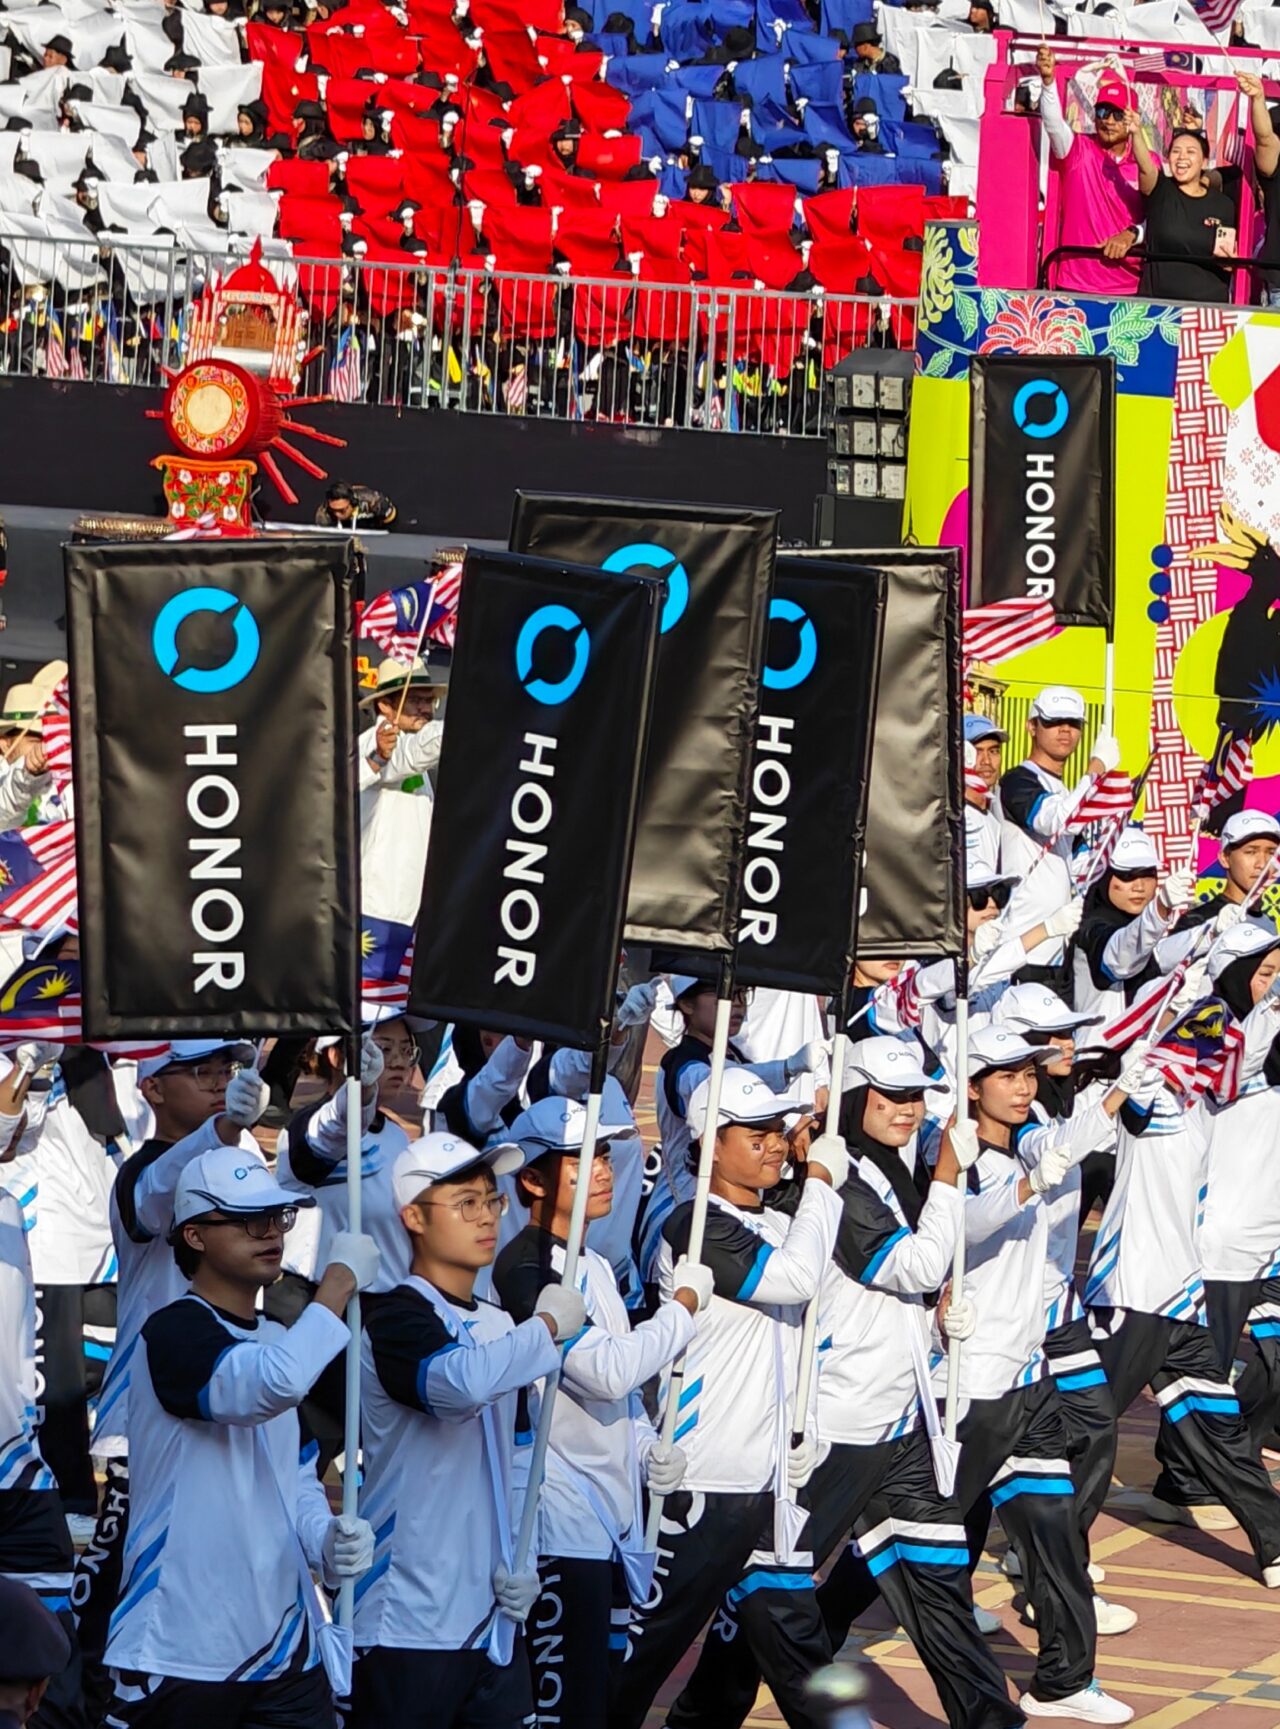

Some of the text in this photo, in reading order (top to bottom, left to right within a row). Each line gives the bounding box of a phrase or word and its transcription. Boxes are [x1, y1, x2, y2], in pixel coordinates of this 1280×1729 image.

[1025, 454, 1055, 598] HONOR
[183, 723, 246, 994] HONOR
[493, 732, 558, 988] HONOR
[738, 714, 795, 946] HONOR
